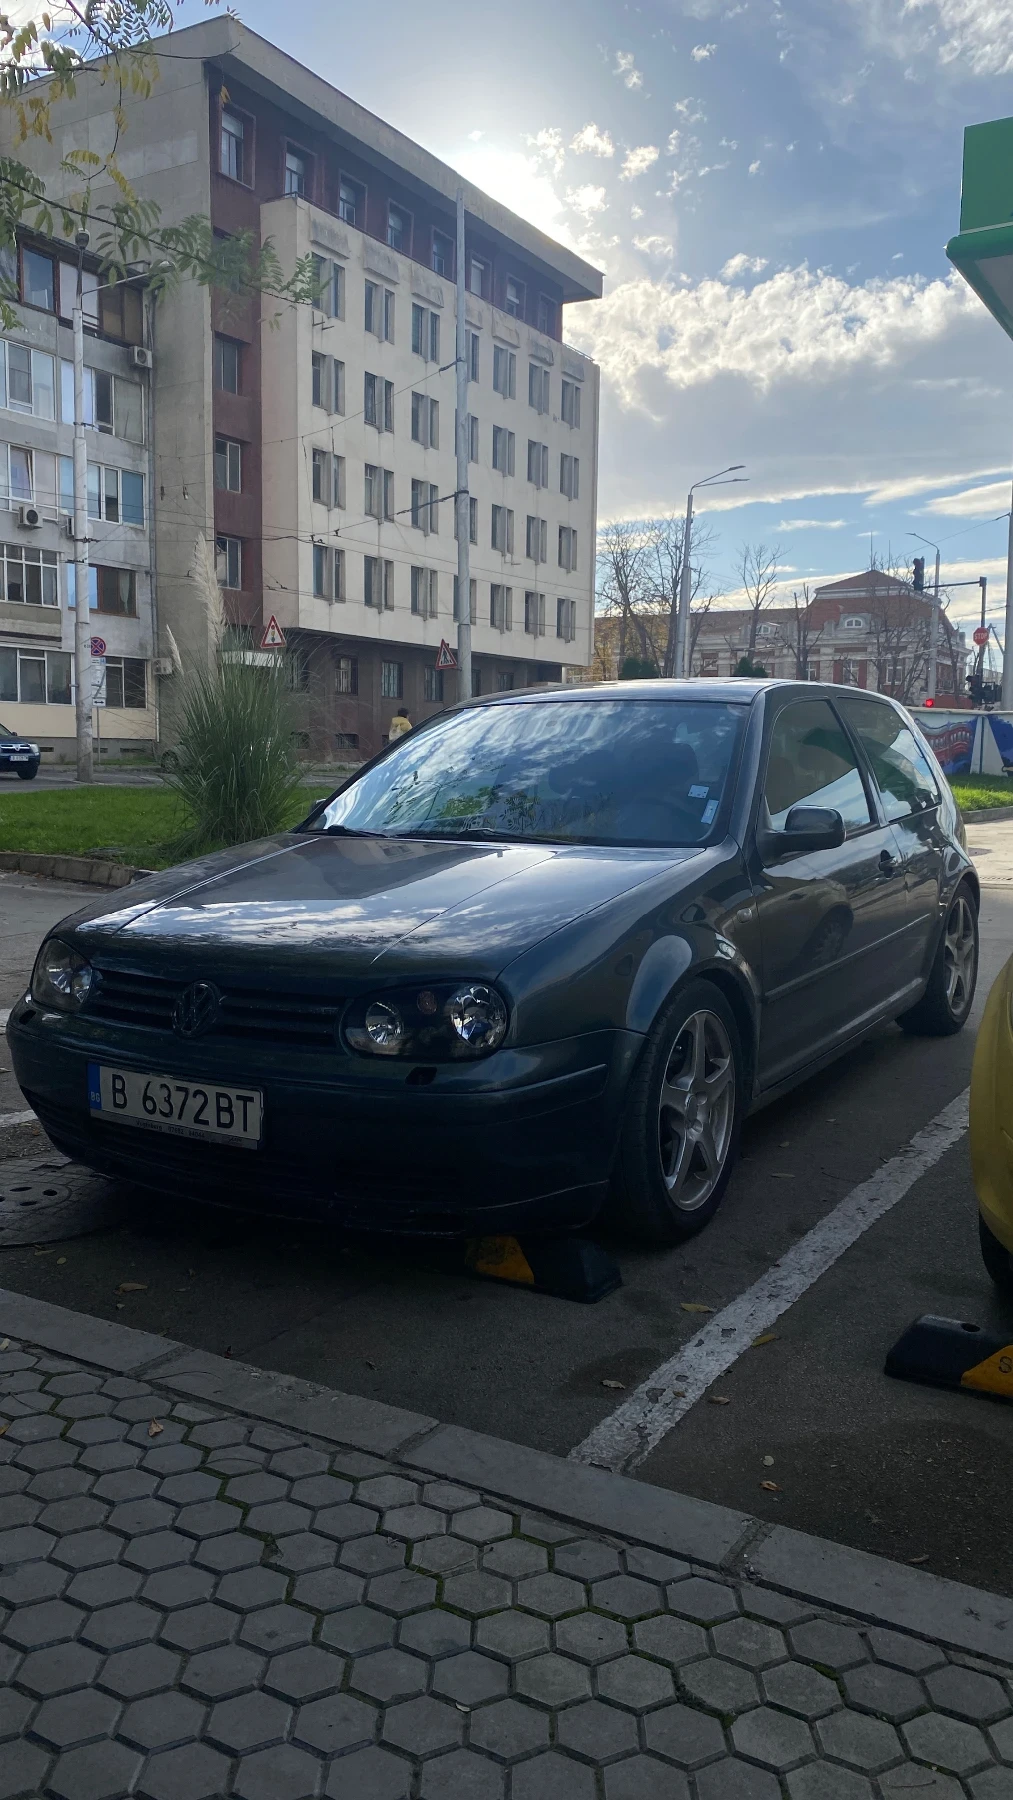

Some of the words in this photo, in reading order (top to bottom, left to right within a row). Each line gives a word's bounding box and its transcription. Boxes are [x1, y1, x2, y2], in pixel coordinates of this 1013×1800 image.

[974, 632, 988, 640] STOP
[90, 1091, 101, 1103] BG
[111, 1073, 128, 1110] B
